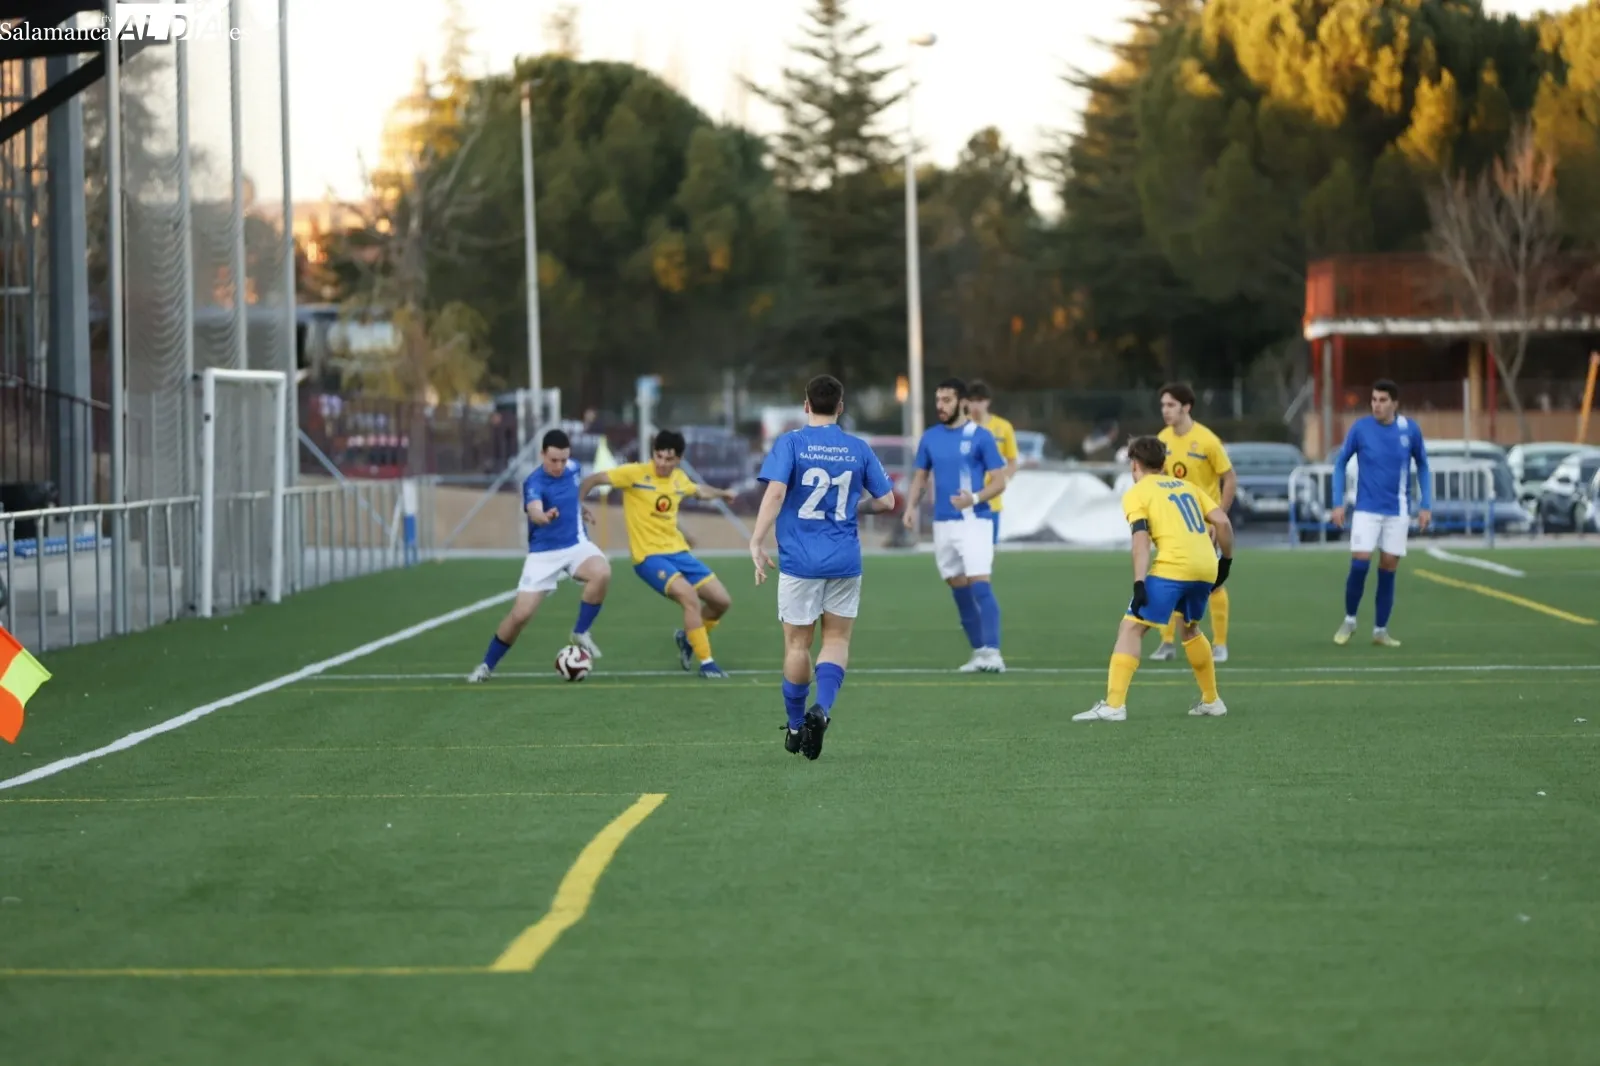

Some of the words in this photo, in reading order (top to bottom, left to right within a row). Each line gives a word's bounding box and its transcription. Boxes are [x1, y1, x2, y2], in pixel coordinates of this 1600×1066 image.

[799, 451, 844, 462] SALAMANCA
[807, 445, 849, 454] DEPORTIVO
[797, 467, 853, 521] 21
[1168, 493, 1206, 534] 10
